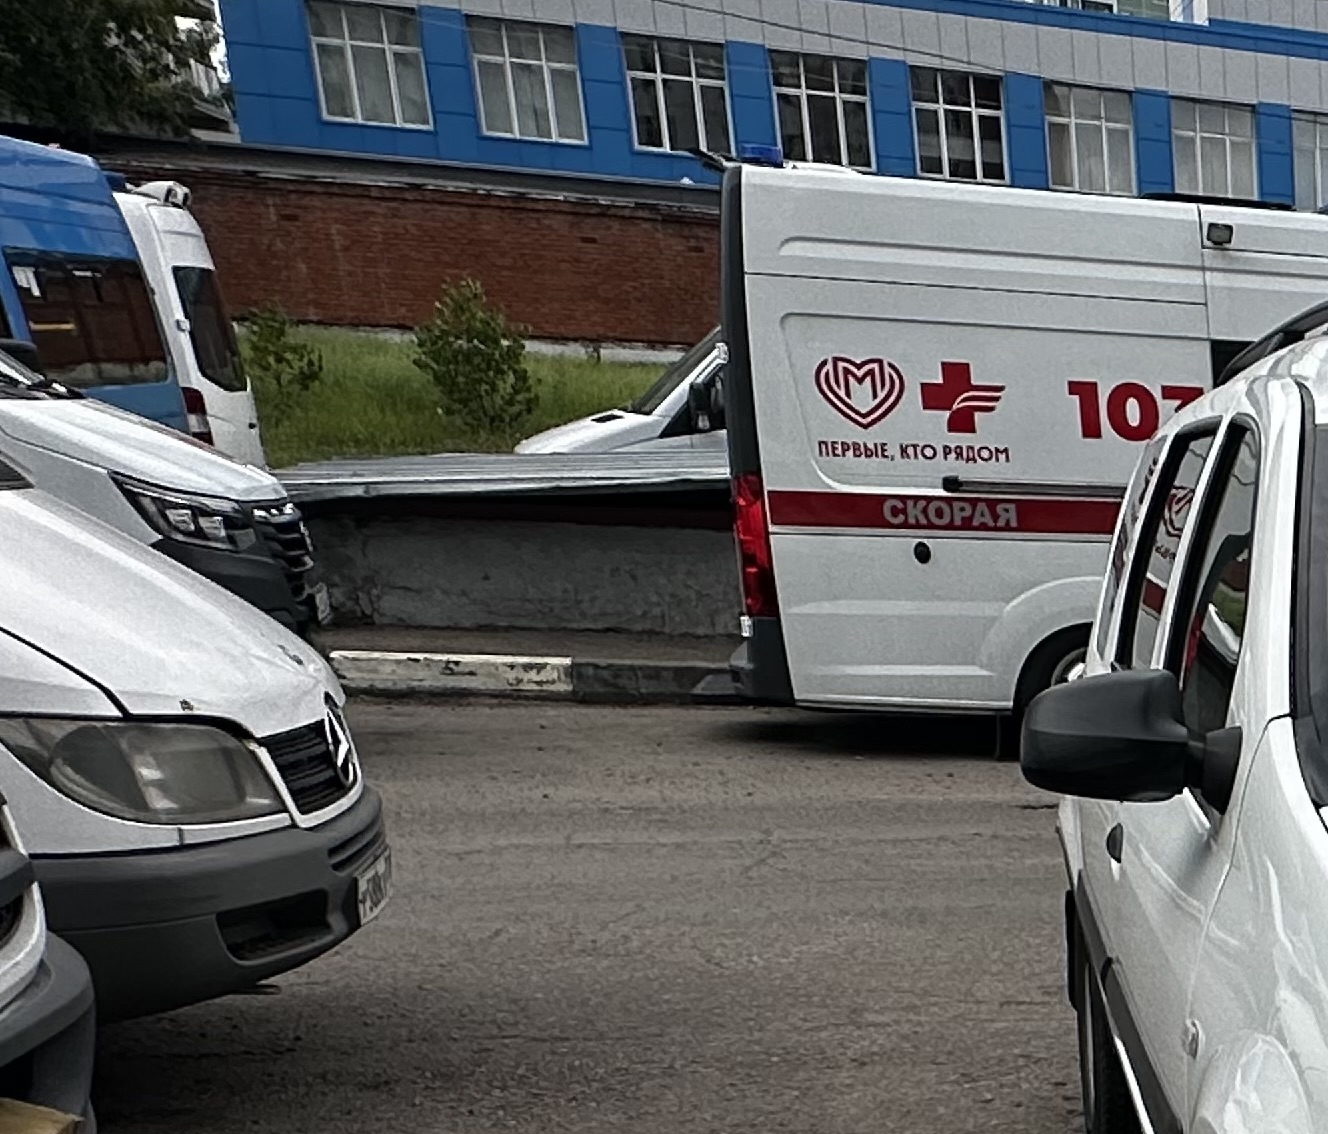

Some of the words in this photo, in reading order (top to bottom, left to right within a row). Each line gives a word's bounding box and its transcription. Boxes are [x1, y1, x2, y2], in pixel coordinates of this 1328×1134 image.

[818, 439, 895, 462] ПЕРВЫЕ,
[899, 443, 937, 461] КТО
[942, 444, 1010, 464] РЯДОМ
[882, 498, 1018, 528] СКОРАЯ
